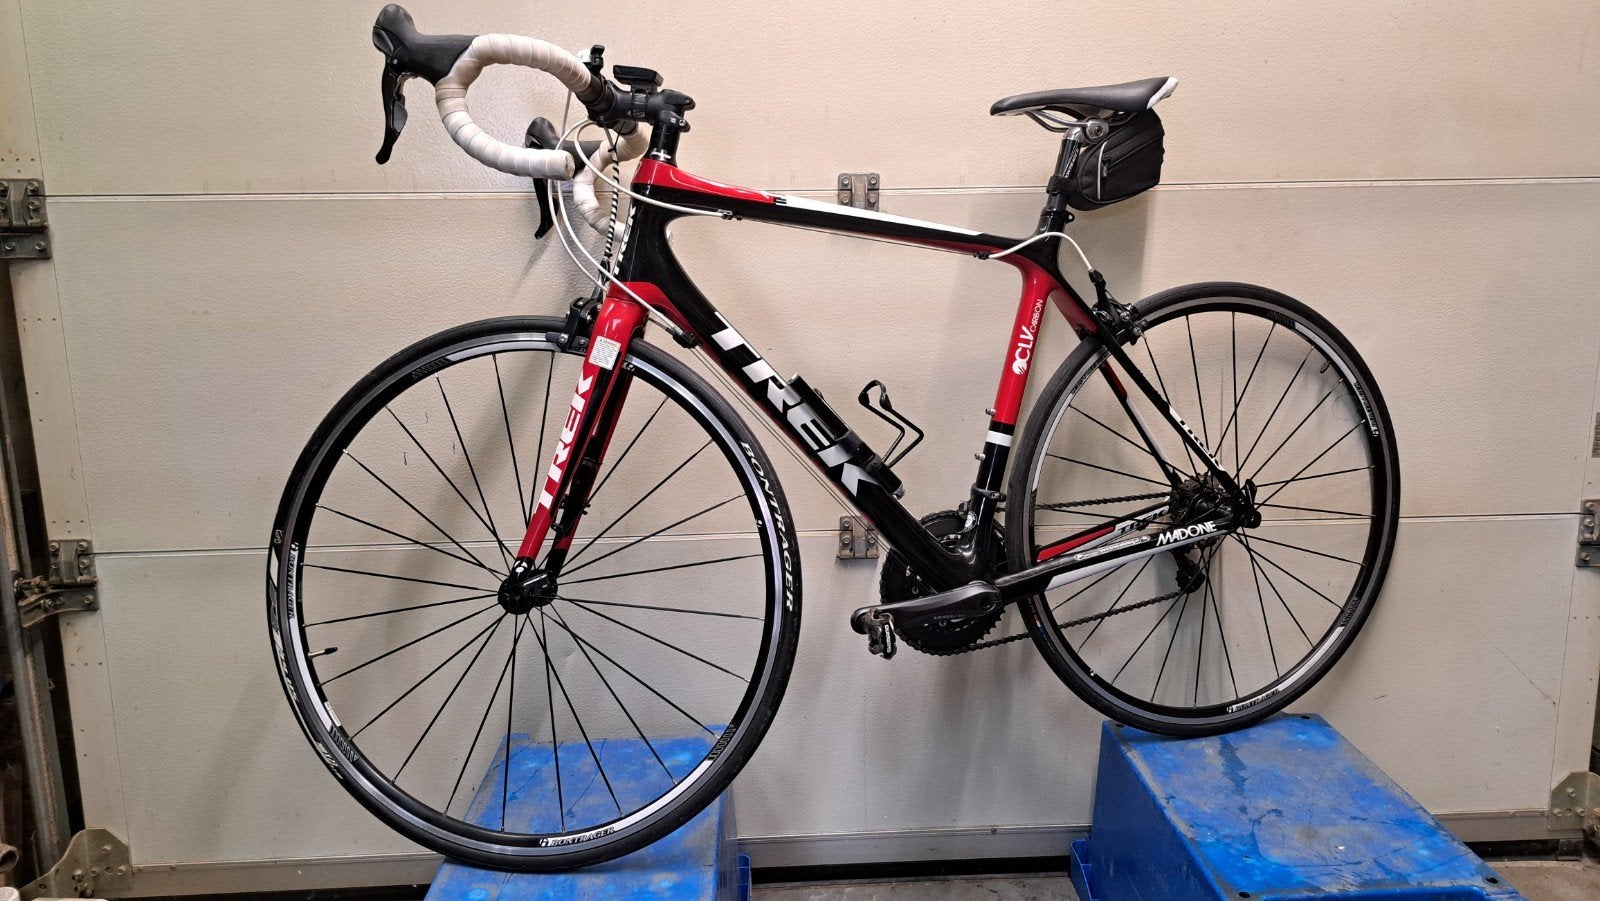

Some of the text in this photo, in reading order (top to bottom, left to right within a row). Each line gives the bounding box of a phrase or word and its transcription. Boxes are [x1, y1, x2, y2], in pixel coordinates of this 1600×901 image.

[1029, 298, 1044, 333] CARBON
[711, 311, 880, 497] TREK
[533, 367, 594, 515] TREK
[740, 441, 794, 612] BONTRAGER
[1156, 520, 1218, 548] MADONE
[288, 552, 297, 619] BONTRAGER
[551, 826, 616, 847] BONTRAGER
